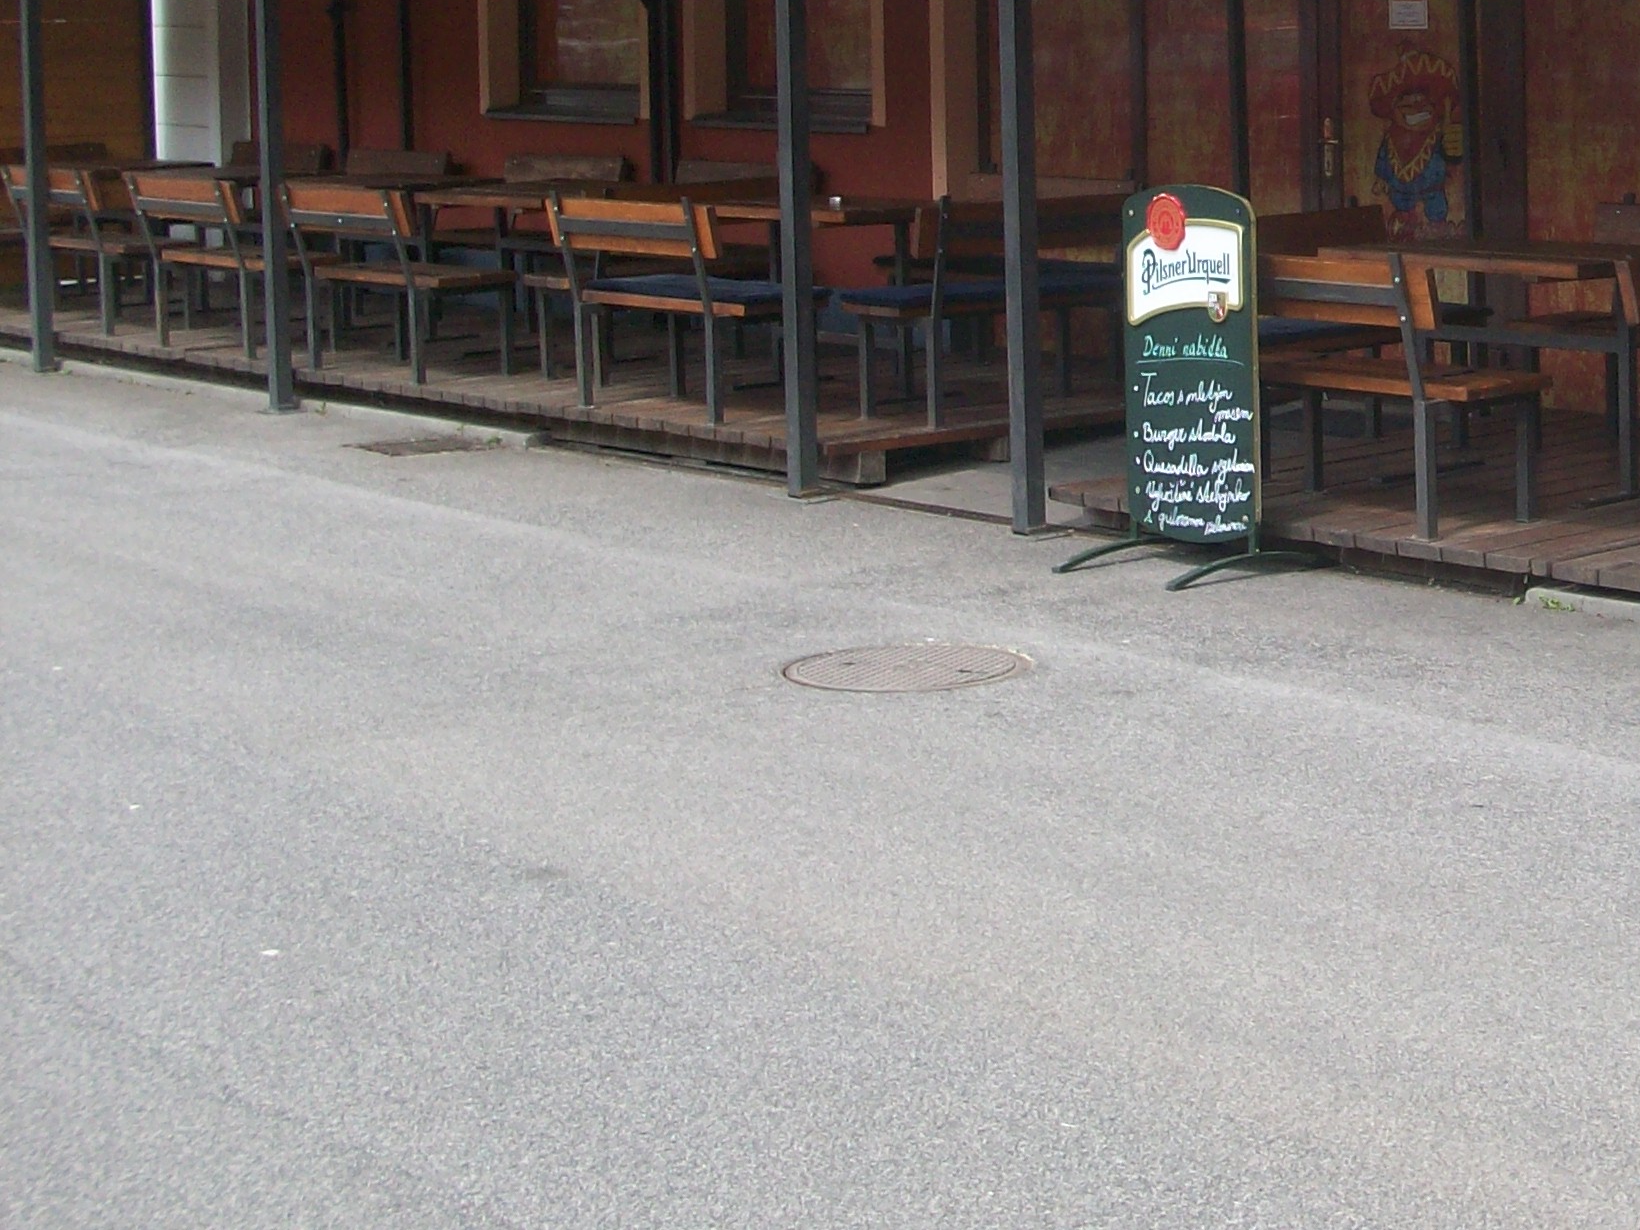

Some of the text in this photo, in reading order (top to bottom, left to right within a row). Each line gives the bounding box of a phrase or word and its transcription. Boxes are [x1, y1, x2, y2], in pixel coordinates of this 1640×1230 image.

[1141, 248, 1230, 295] Pilsner Urquell
[1141, 373, 1175, 407] Tacos
